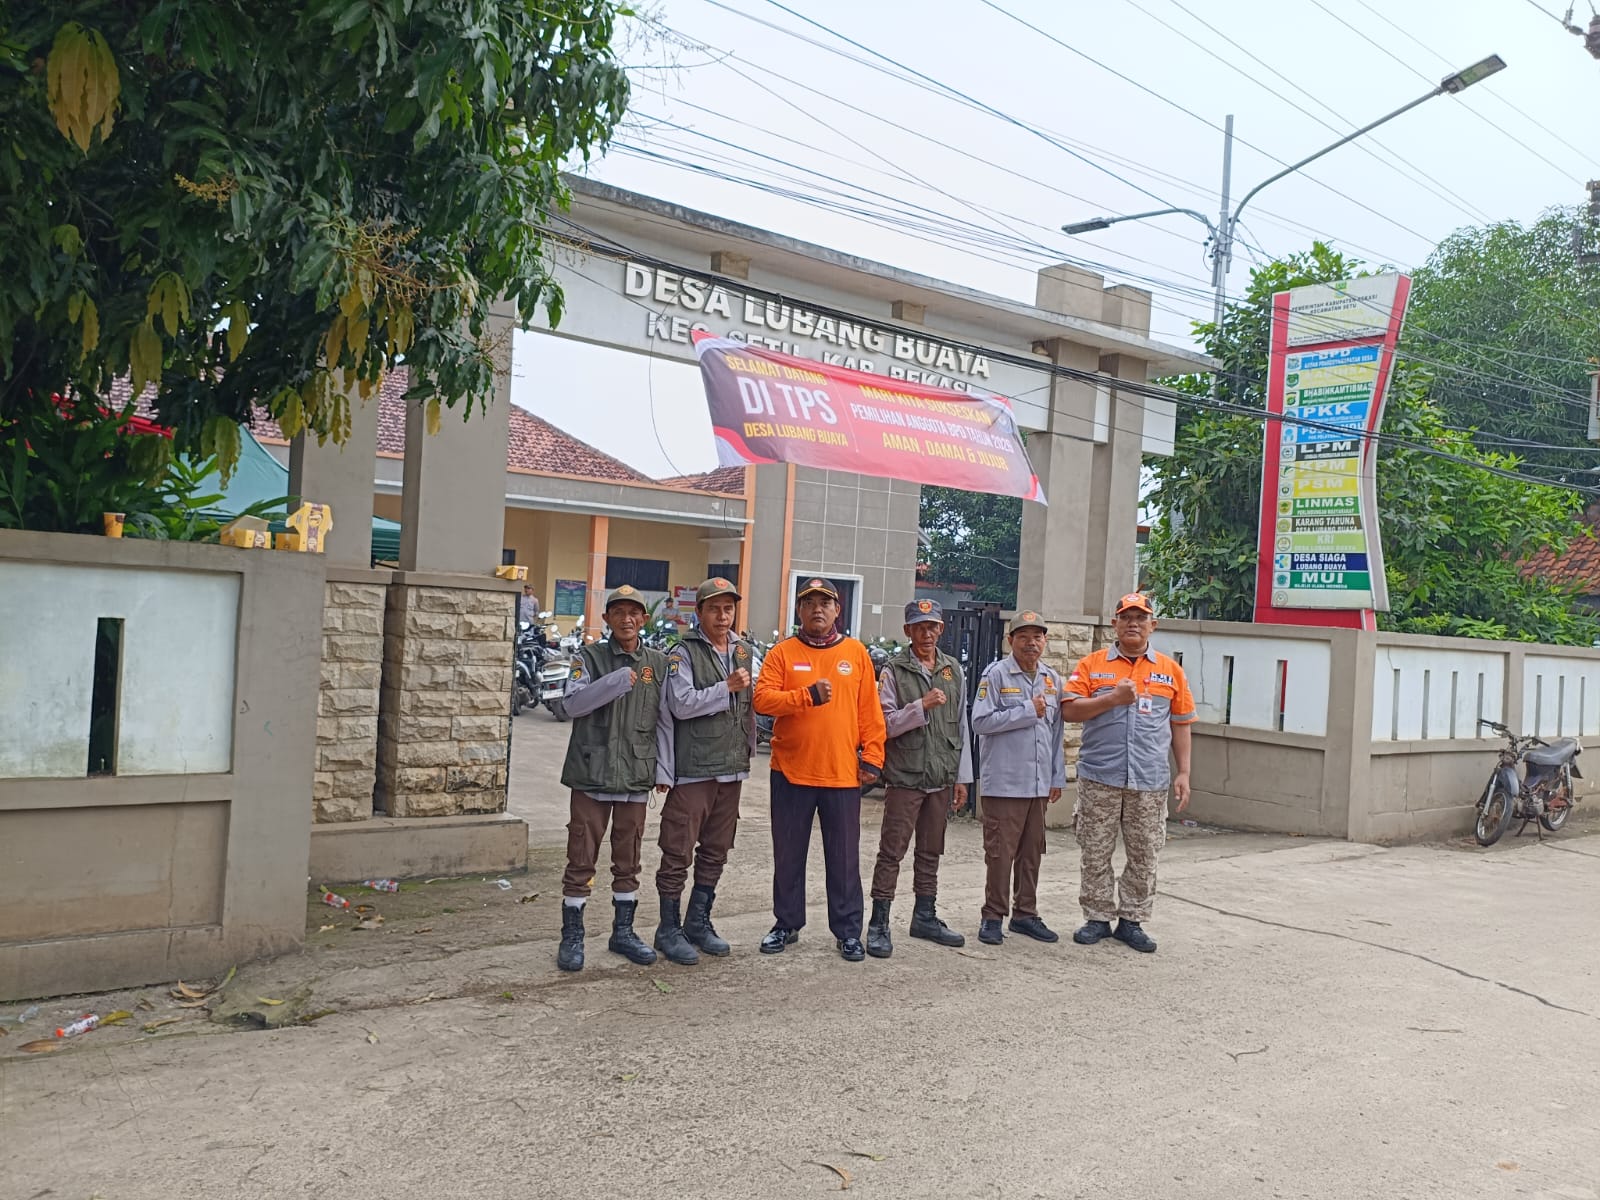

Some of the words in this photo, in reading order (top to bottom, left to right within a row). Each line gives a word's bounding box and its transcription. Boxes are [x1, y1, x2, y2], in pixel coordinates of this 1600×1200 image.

[625, 262, 731, 318] DESA
[744, 294, 885, 352] LUBANG
[895, 335, 991, 378] BUAYA
[725, 355, 781, 377] SELAMAT
[784, 366, 828, 386] DATANG
[736, 377, 776, 416] DI
[774, 382, 838, 425] TPS
[859, 384, 896, 403] MARI
[895, 392, 925, 409] KITA
[924, 398, 992, 425] SUKSESKAN
[1303, 403, 1351, 418] PKK
[850, 402, 906, 428] PEMILIHAN
[905, 413, 949, 436] ANGGOTA
[743, 422, 775, 438] DESA
[775, 423, 817, 442] LUBANG
[816, 430, 849, 447] BUAYA
[882, 431, 925, 456] AMAN,
[925, 439, 966, 461] DAMAI
[976, 450, 1009, 471] JUJUR
[1301, 441, 1351, 453] LPM
[1299, 460, 1345, 472] KPM
[1298, 479, 1343, 490] PSM
[1296, 497, 1354, 508] LINMAS
[1296, 518, 1325, 527] KARANG
[1325, 517, 1355, 526] TARUNA
[1294, 553, 1316, 562] DESA
[1319, 553, 1346, 562] SIAGA
[1302, 572, 1343, 584] MUI
